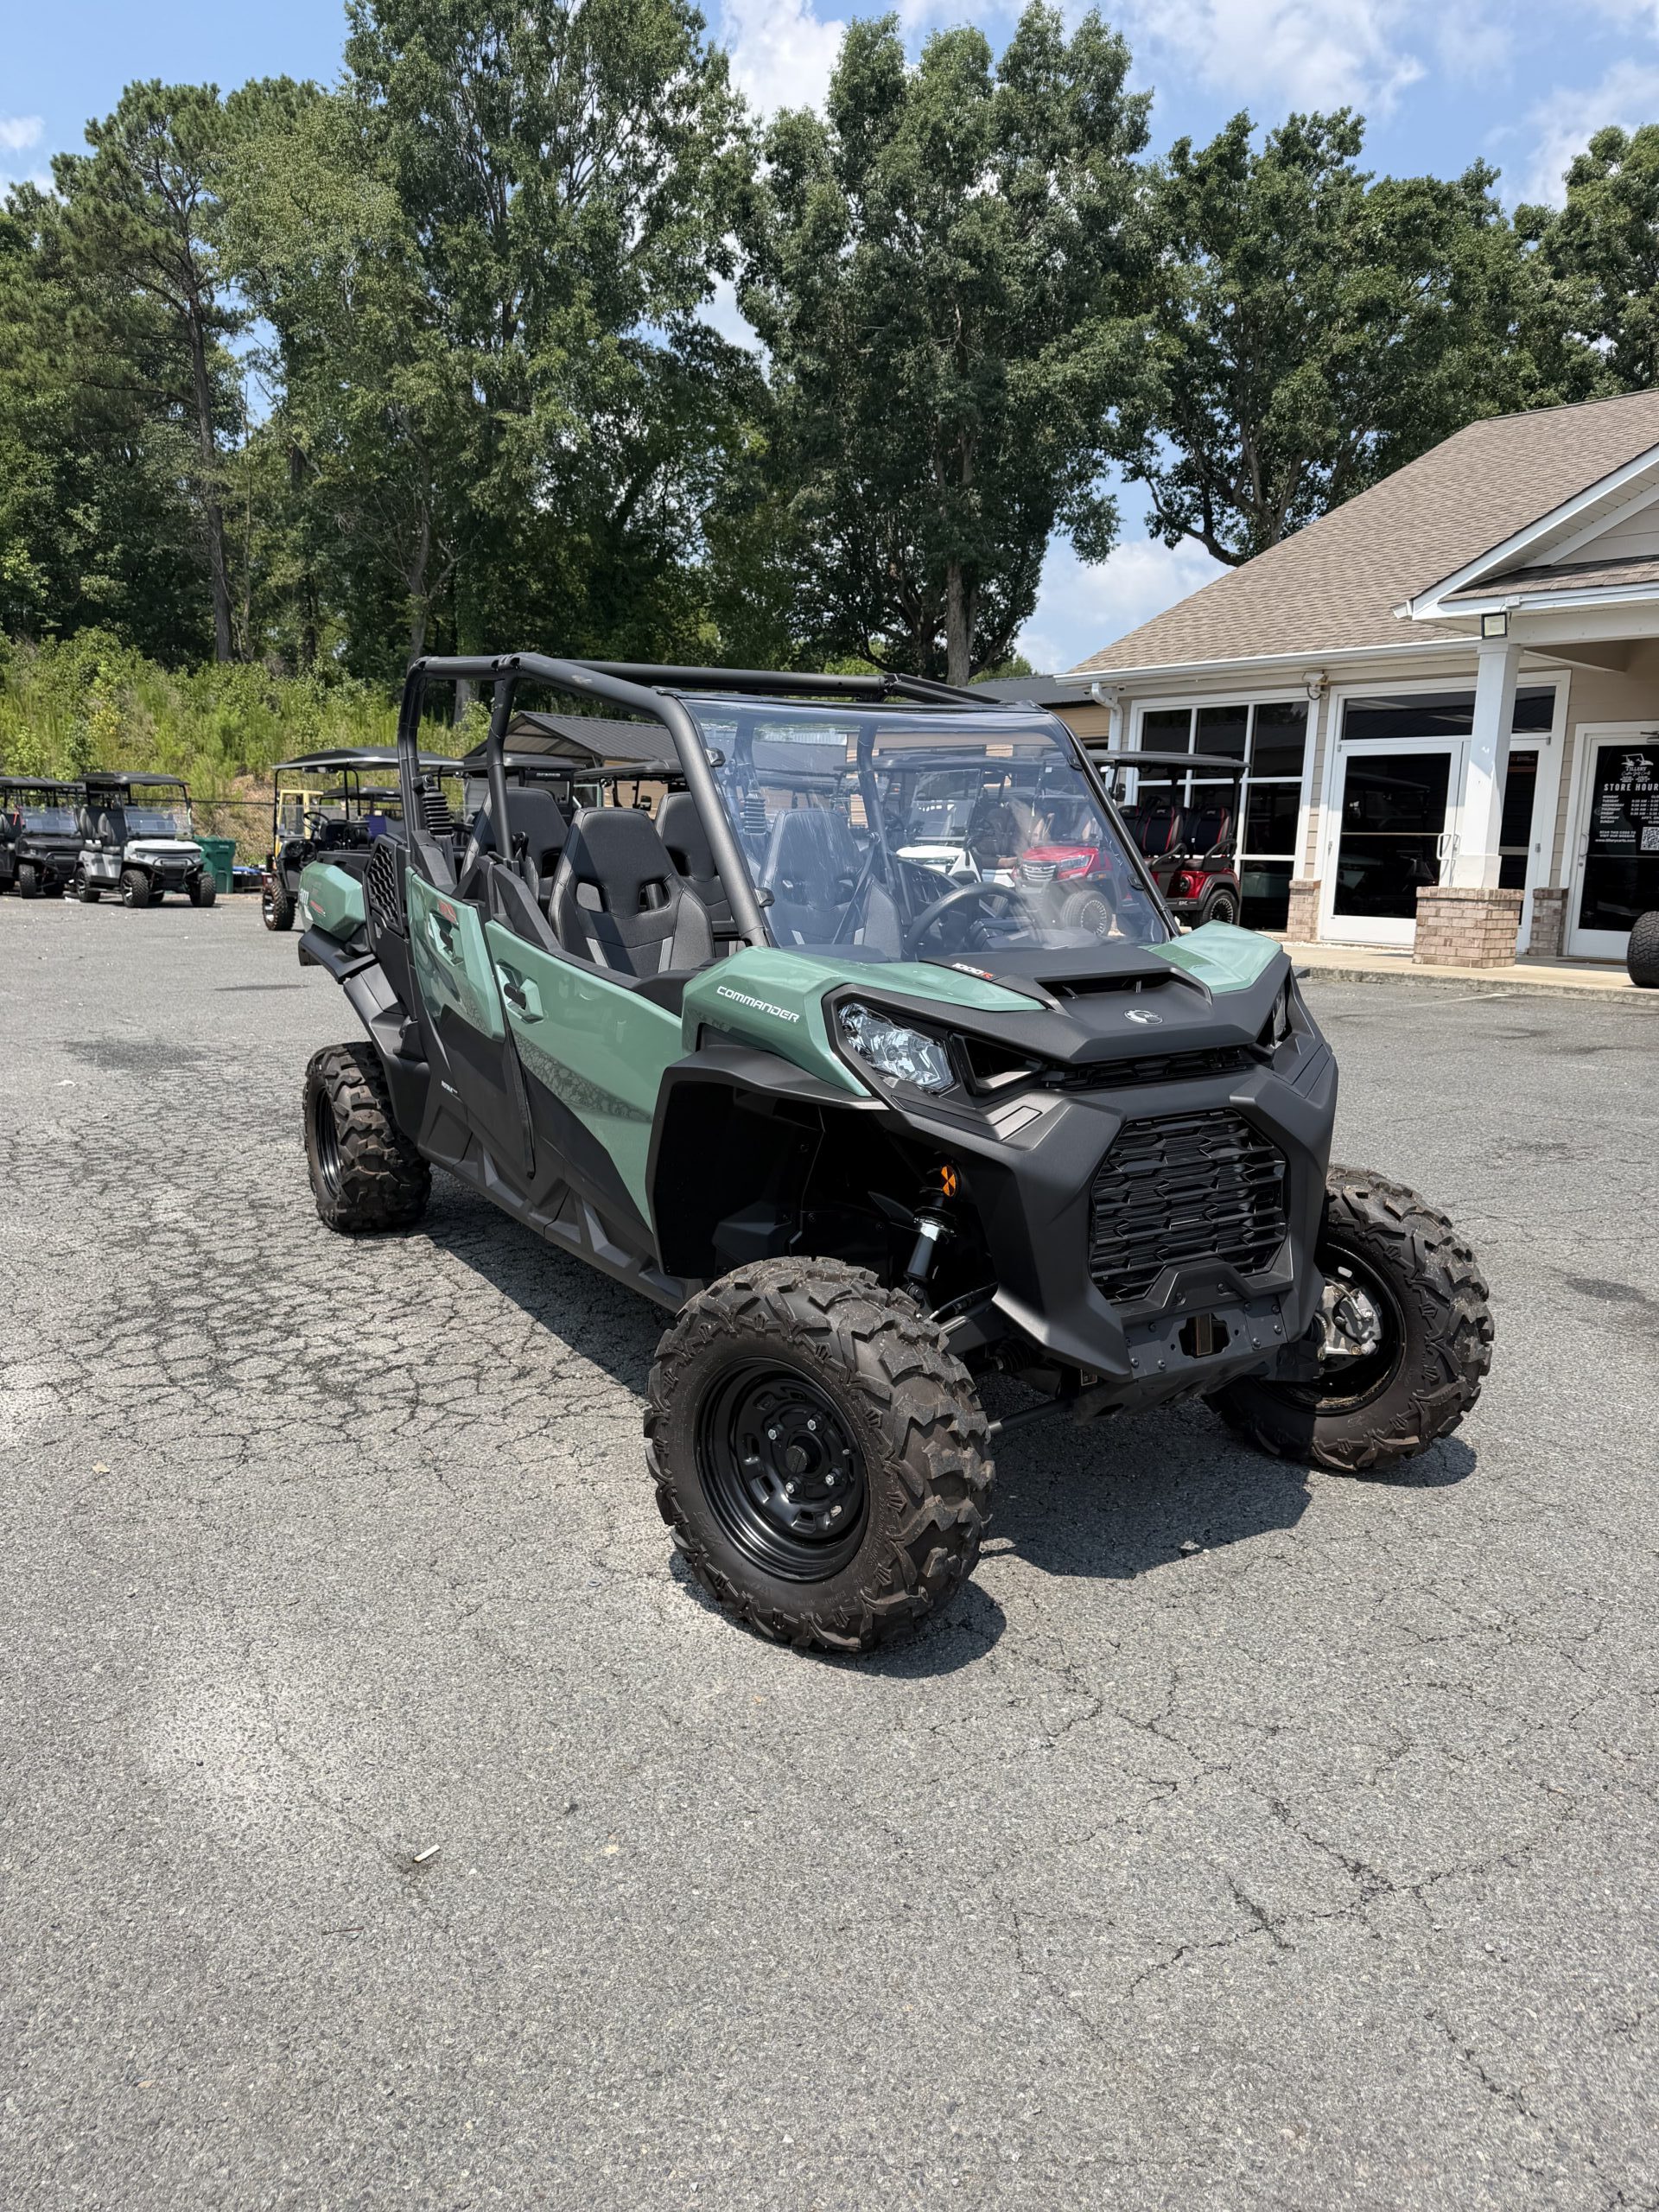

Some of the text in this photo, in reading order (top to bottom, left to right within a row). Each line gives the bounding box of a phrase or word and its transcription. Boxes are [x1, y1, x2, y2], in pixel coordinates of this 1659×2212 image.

[1603, 783, 1659, 791] STORE HOUR
[716, 985, 800, 1023] COMMANDER
